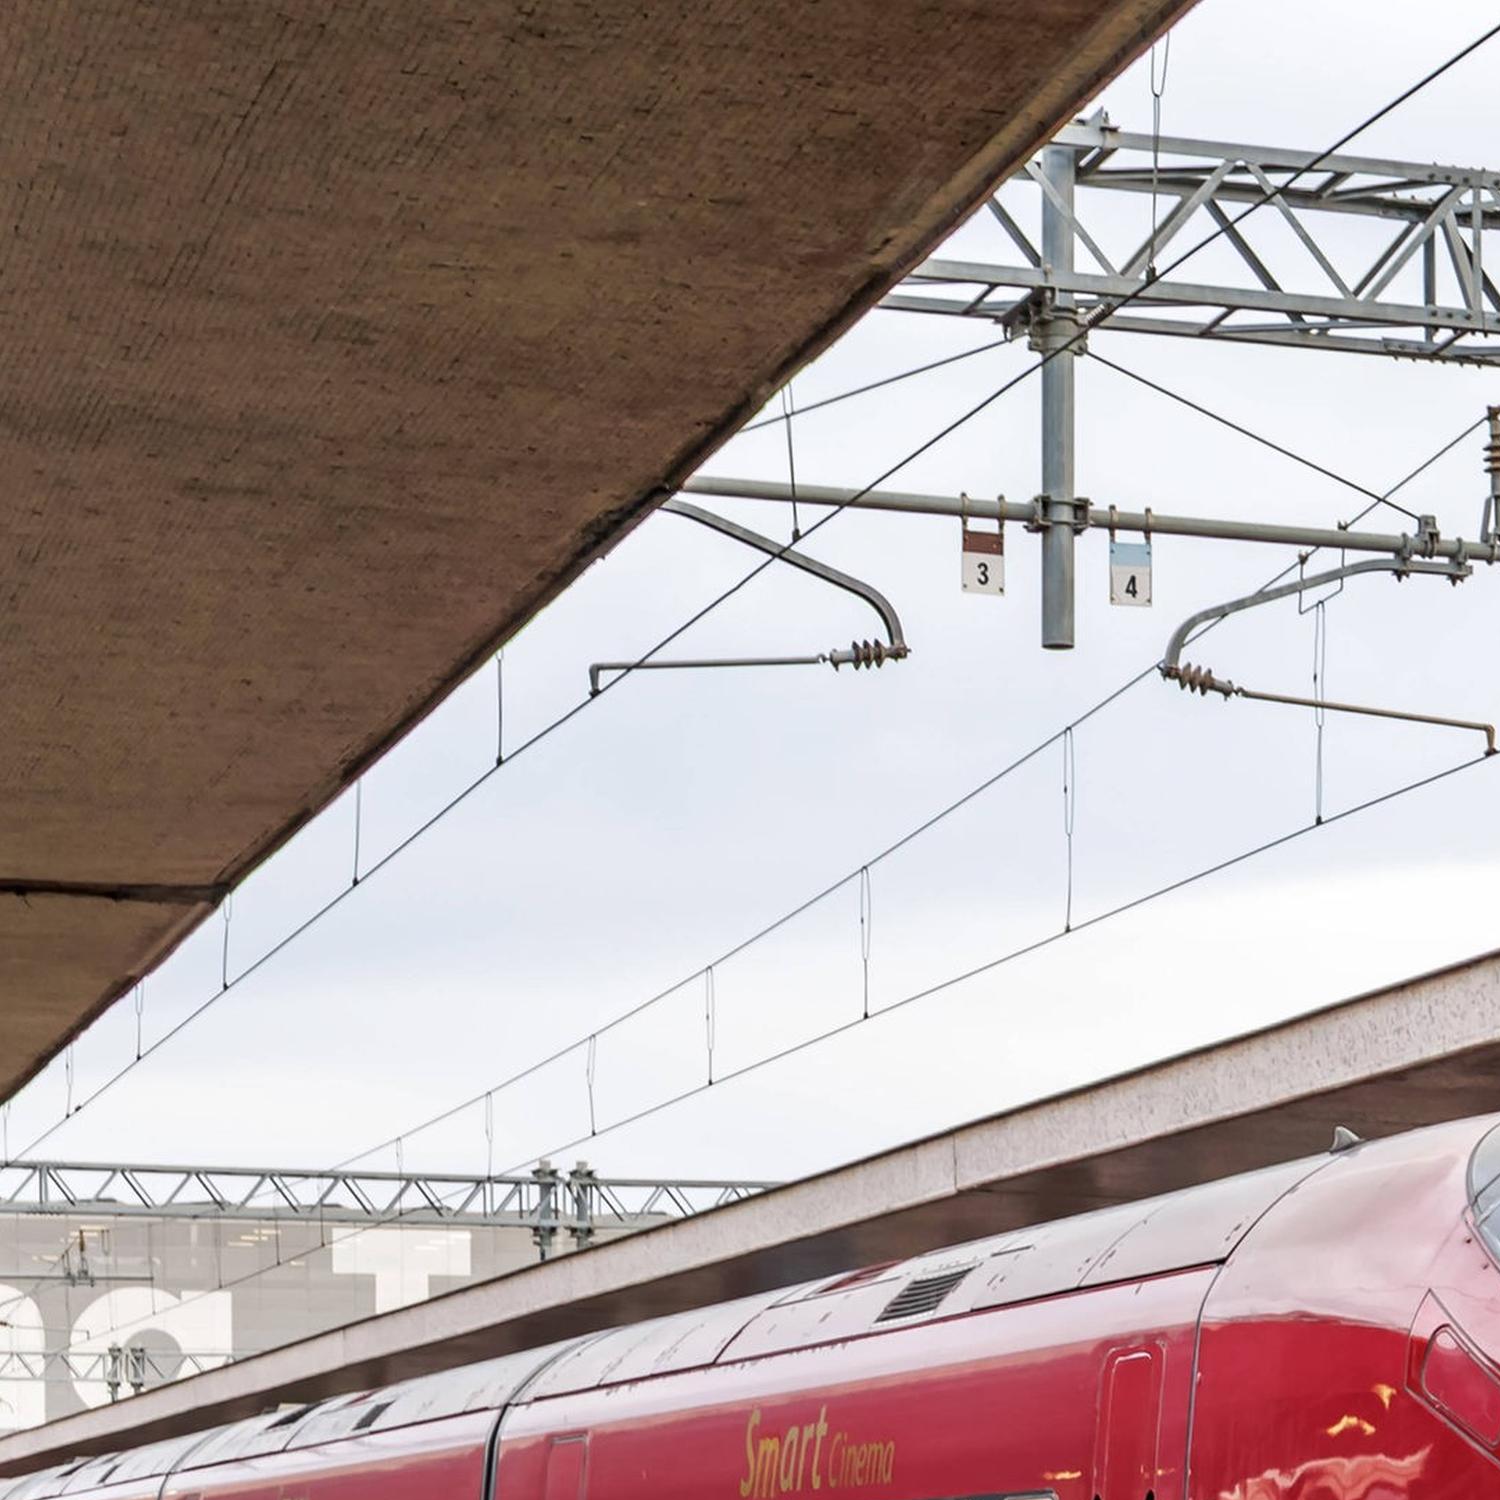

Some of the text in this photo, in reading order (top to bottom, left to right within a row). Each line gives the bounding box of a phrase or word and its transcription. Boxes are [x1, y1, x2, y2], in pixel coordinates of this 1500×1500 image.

[977, 562, 989, 585] 3
[1125, 575, 1138, 598] 4
[740, 1405, 895, 1499] Smart Cinema
